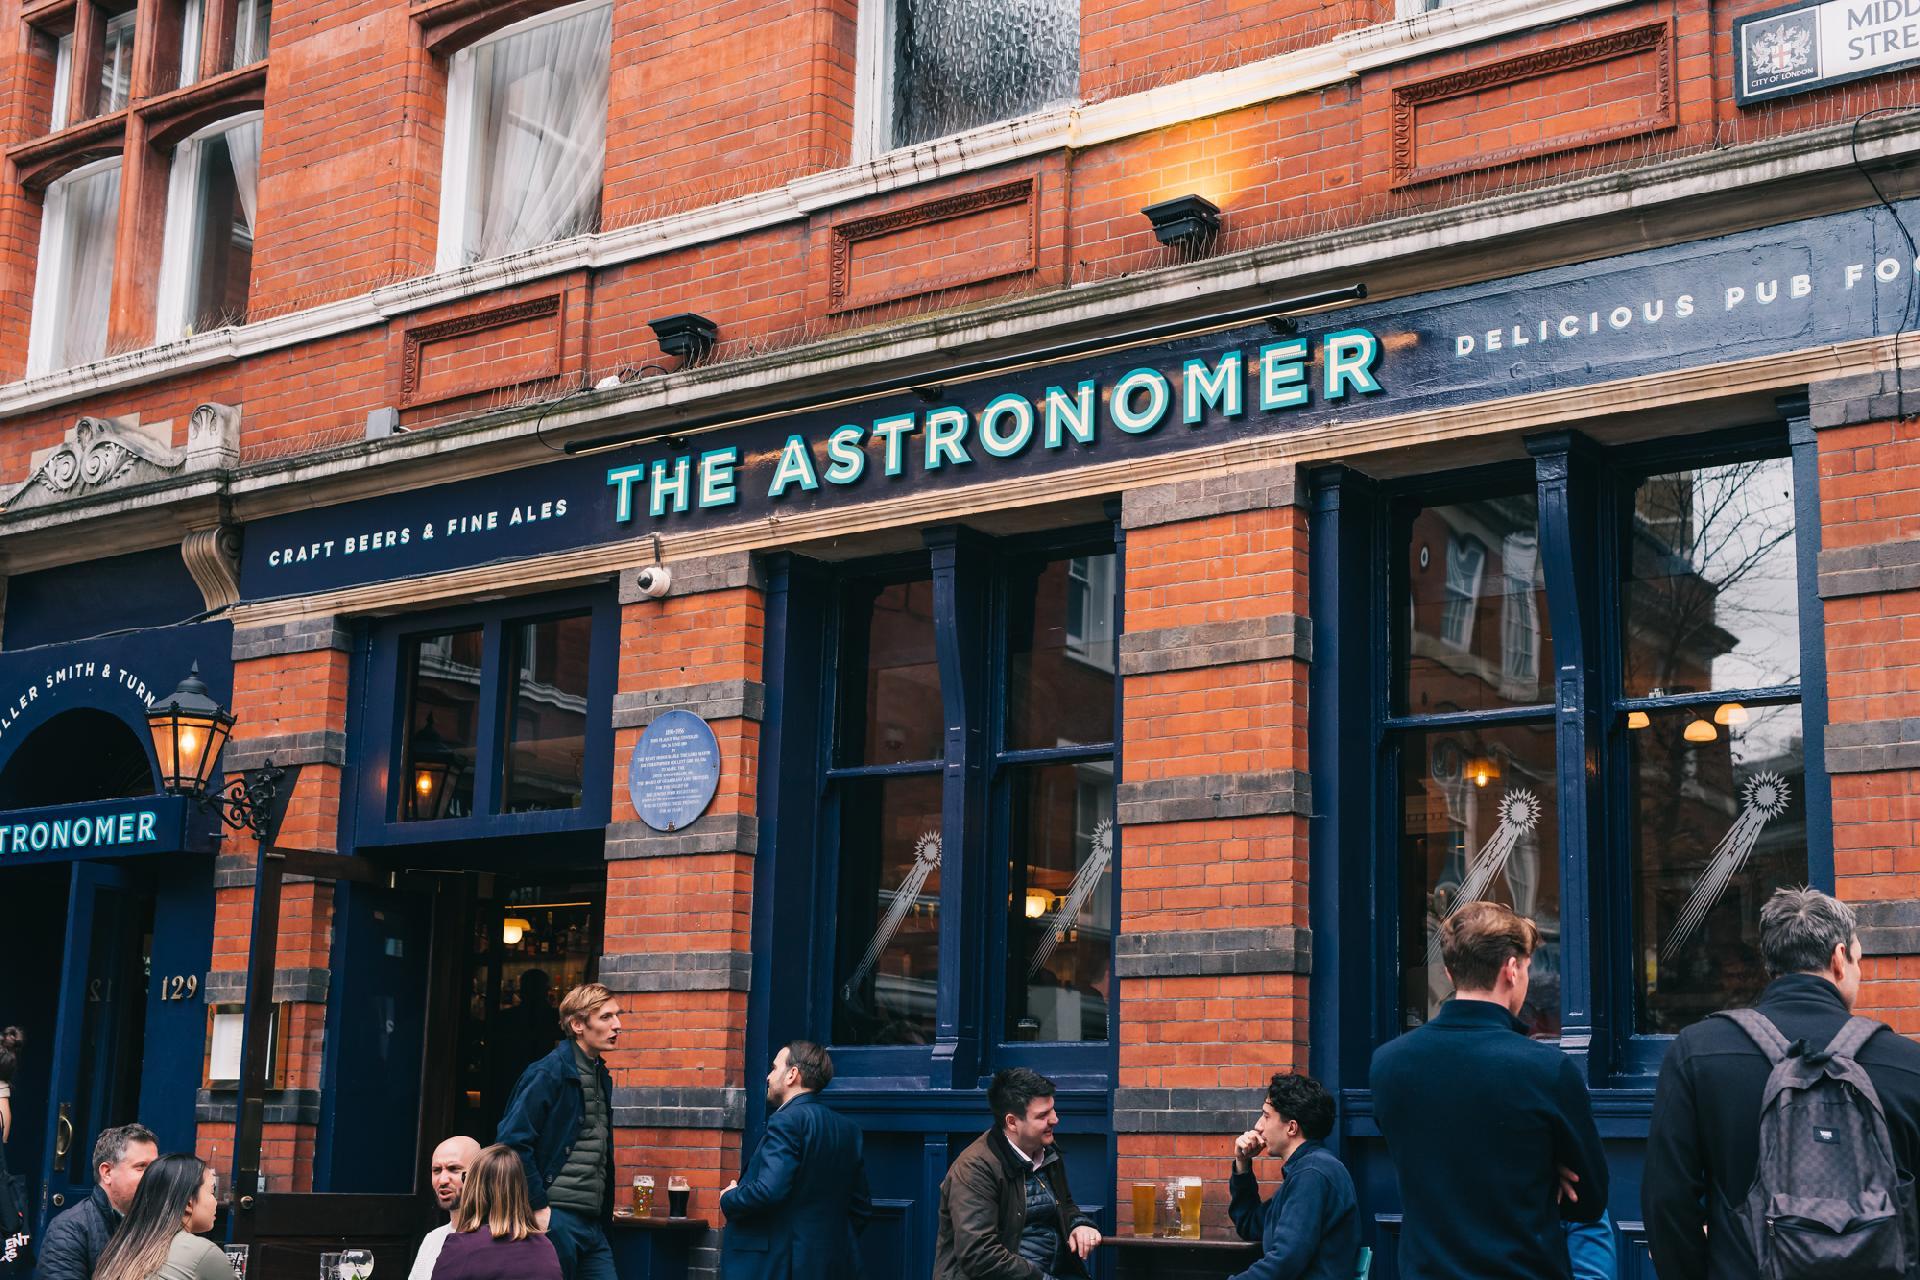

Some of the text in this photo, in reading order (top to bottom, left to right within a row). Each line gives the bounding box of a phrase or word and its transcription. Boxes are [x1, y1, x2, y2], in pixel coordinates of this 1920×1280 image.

[1847, 0, 1920, 30] MIDD
[1848, 24, 1919, 61] STRE
[1751, 67, 1814, 87] CITY OF LONDON
[1456, 255, 1920, 357] DELICIOUS PUB FO
[606, 328, 1382, 523] THE ASTRONOMER
[268, 499, 568, 567] CRAFT BEERS & FINE ALES
[0, 662, 156, 738] LLER SMITH & TURN
[0, 811, 157, 854] TRONOMER
[161, 974, 198, 1001] 129
